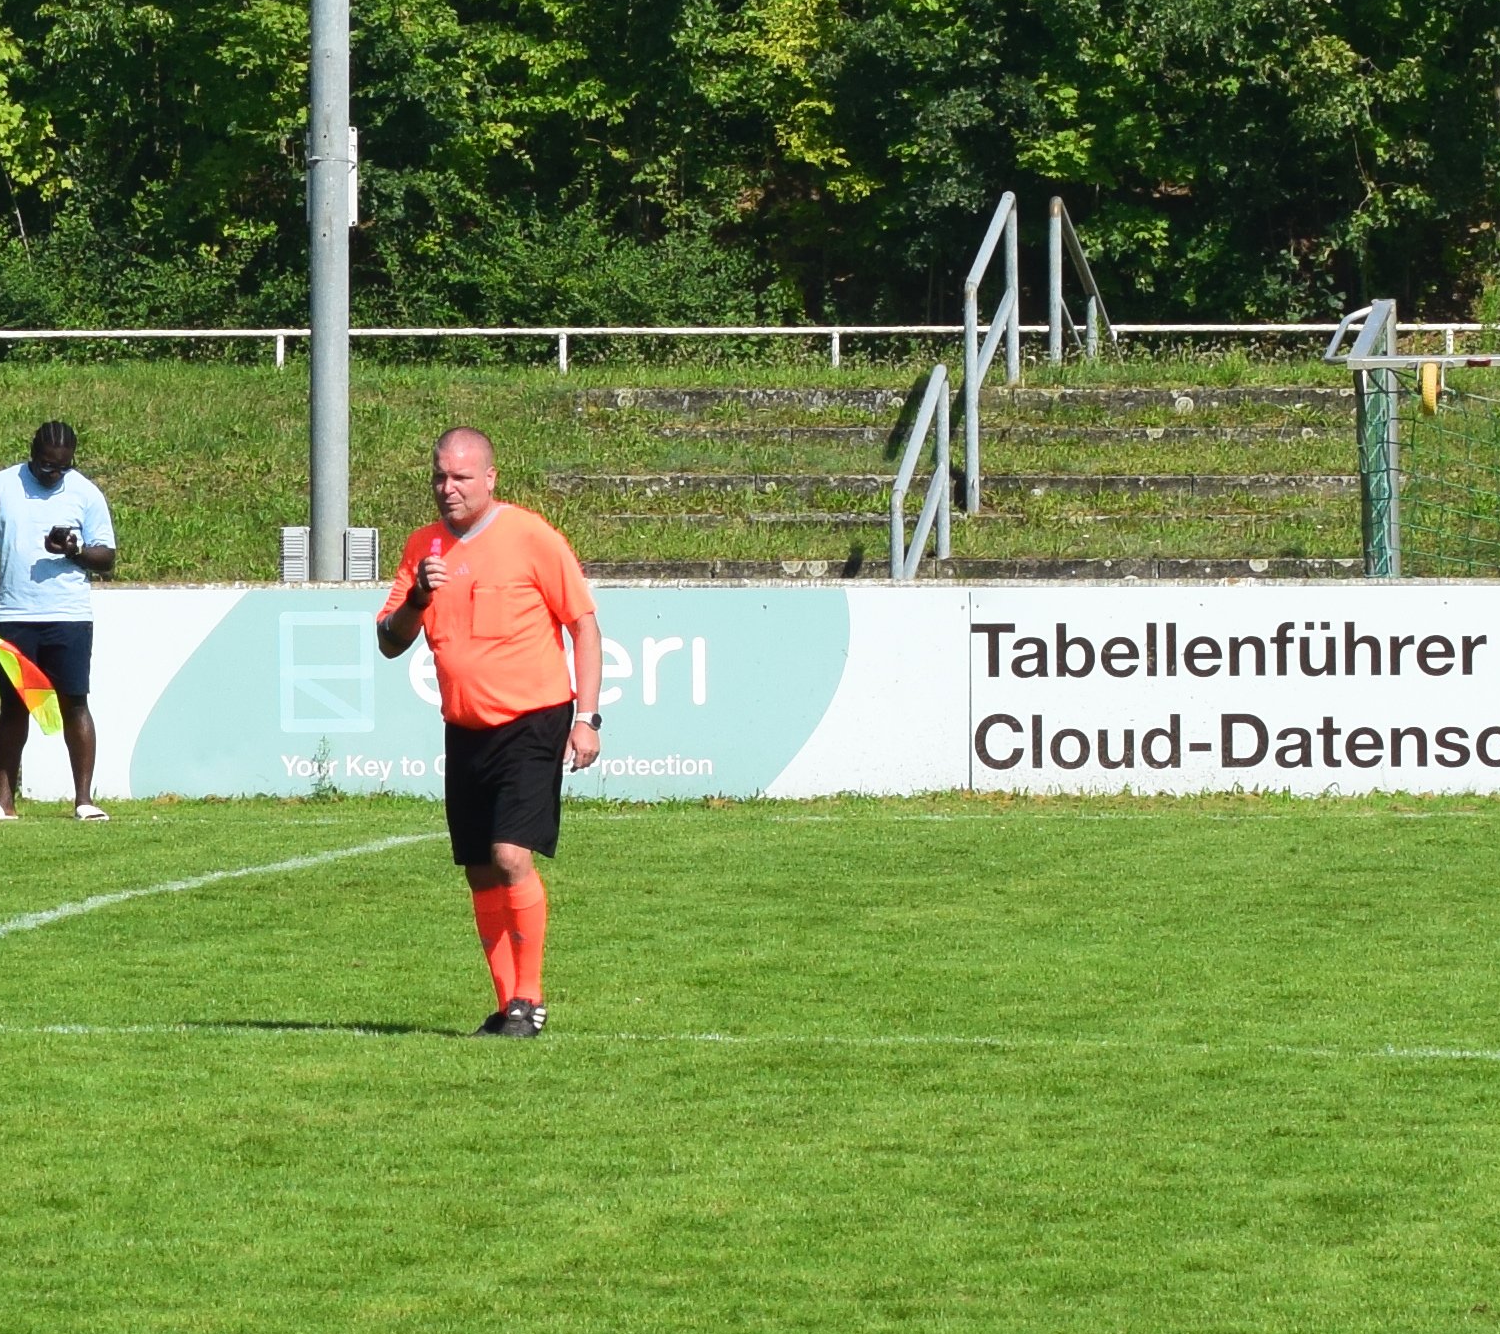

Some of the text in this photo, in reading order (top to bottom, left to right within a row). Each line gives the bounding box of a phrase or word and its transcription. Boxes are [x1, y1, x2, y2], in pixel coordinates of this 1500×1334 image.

[970, 620, 1487, 678] Tabellenführer
[346, 754, 394, 782] Key
[400, 756, 426, 777] to
